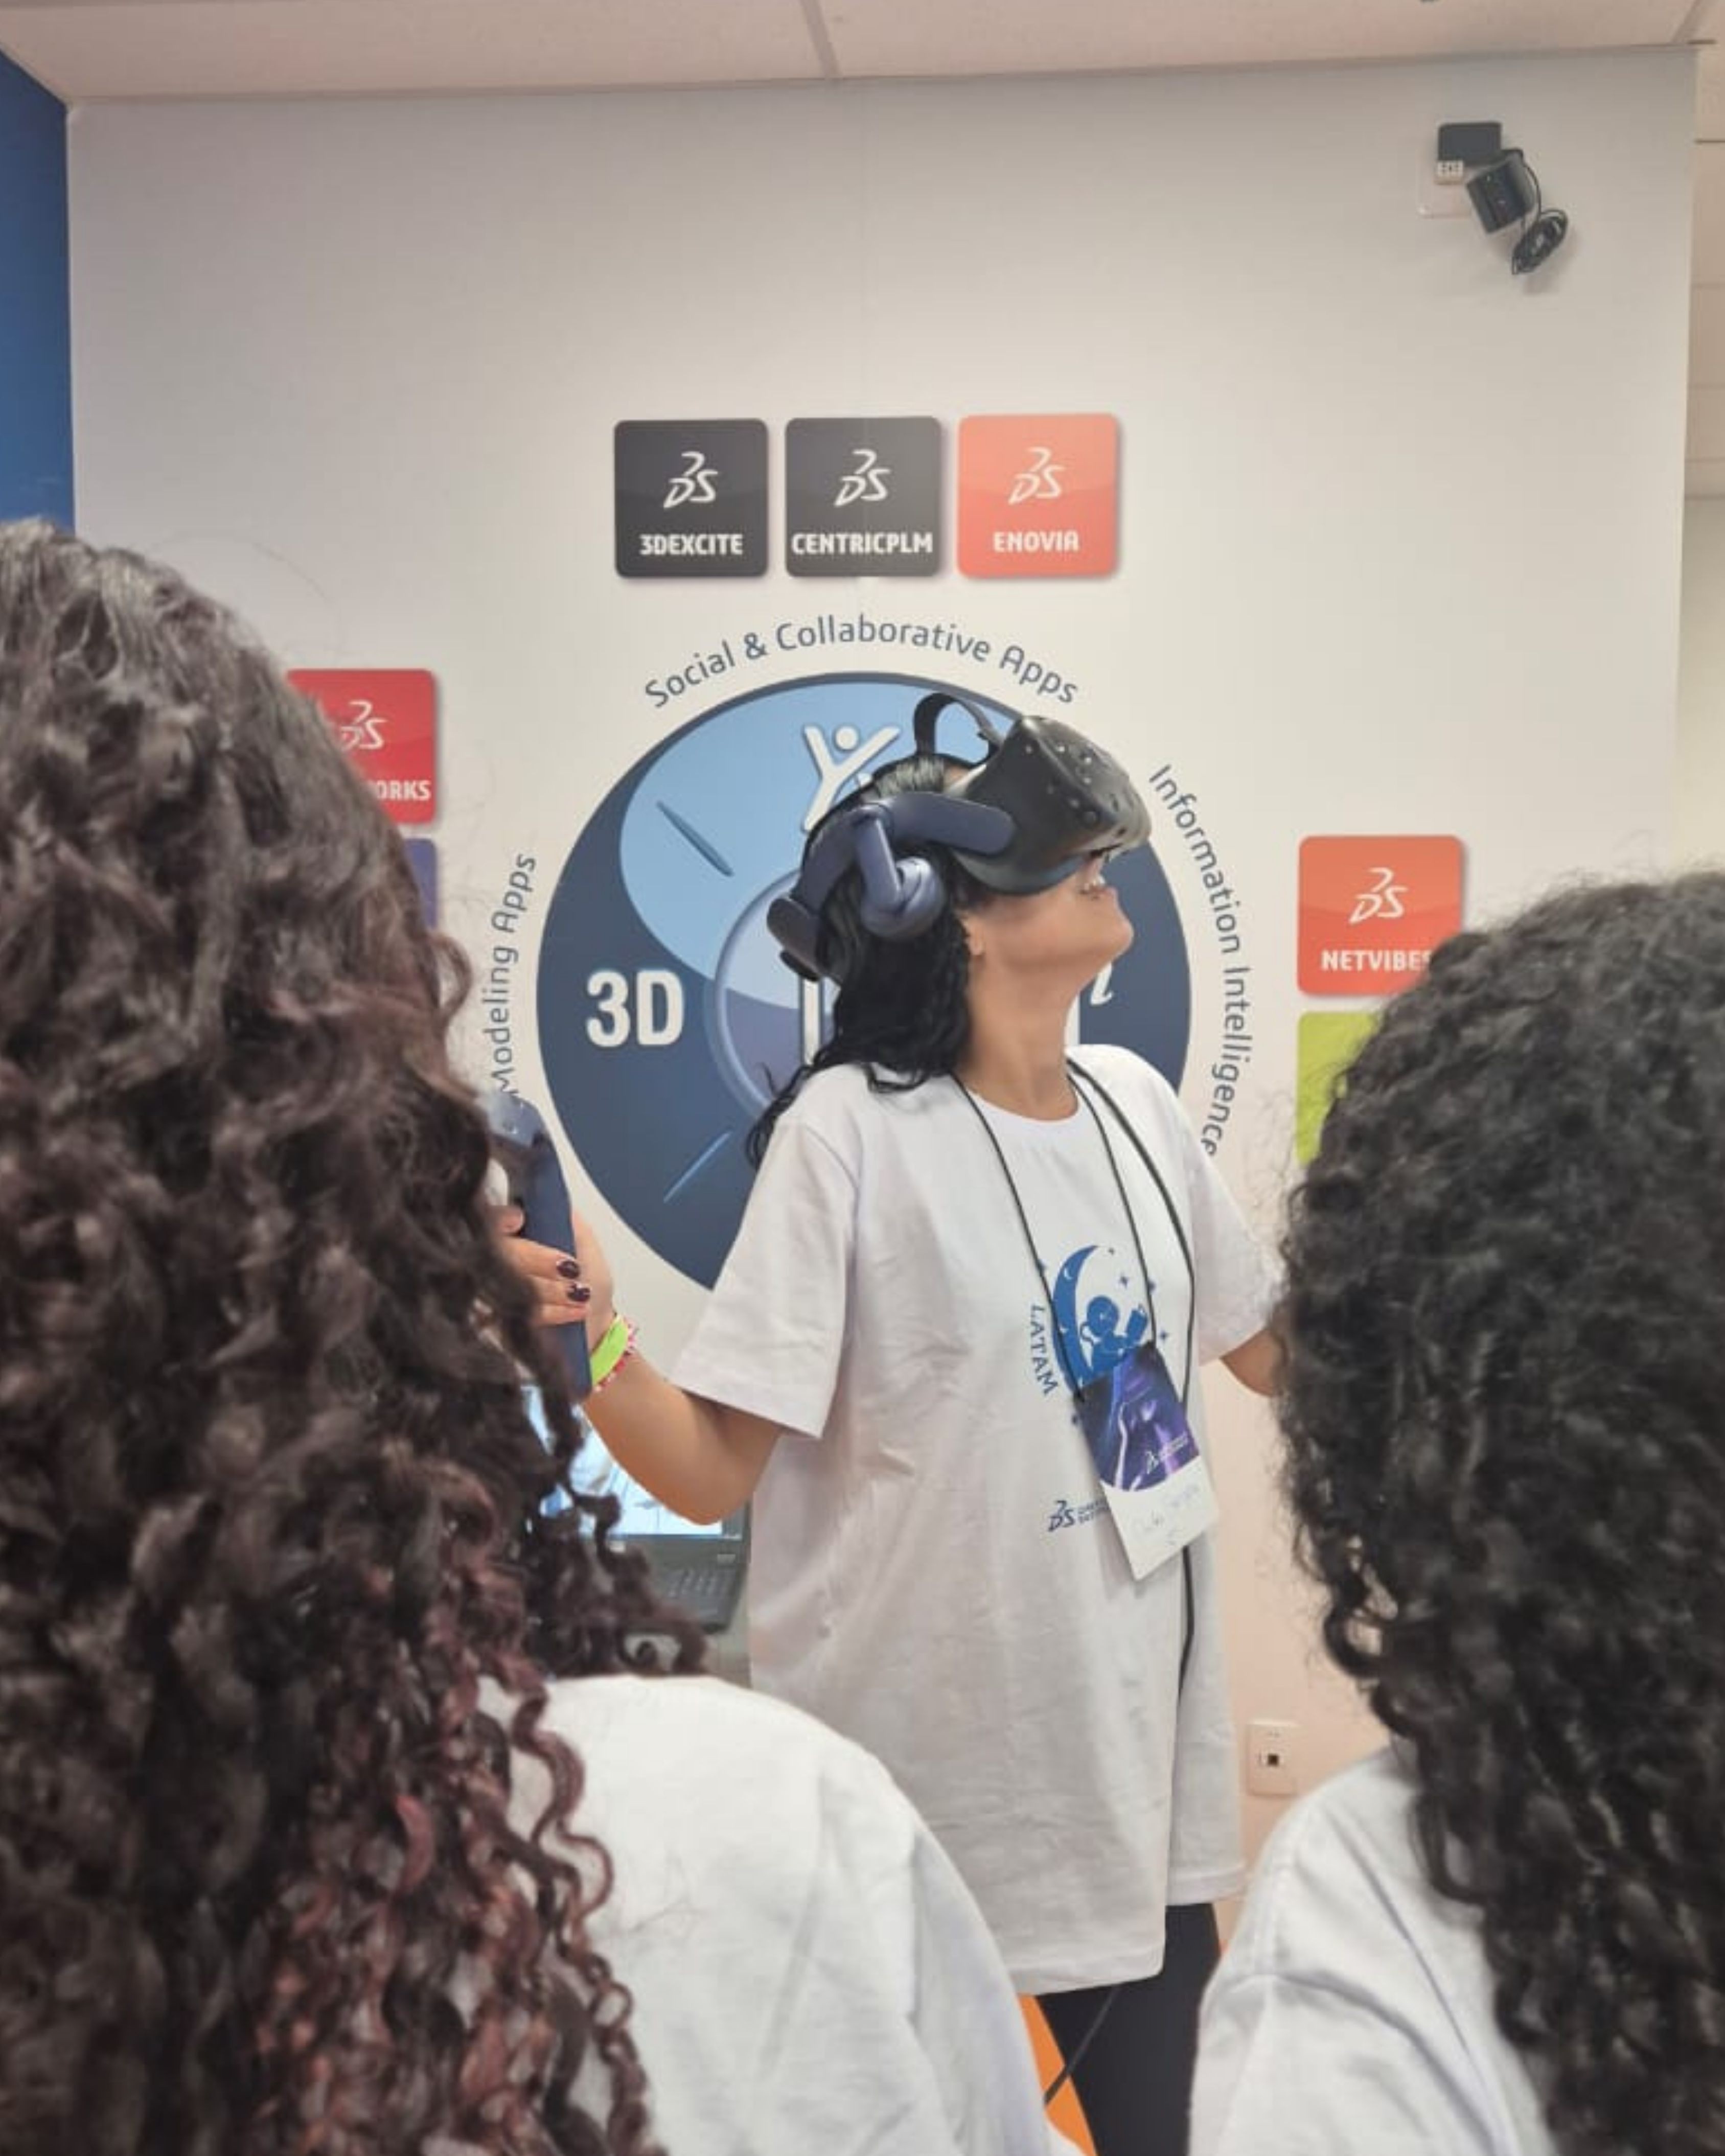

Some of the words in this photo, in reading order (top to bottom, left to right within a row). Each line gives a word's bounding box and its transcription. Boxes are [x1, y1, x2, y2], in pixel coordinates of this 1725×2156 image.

[640, 533, 743, 555] 3DEXCITE
[792, 532, 933, 554] CENTRICPLM
[993, 530, 1079, 552] ENOVIA
[645, 640, 735, 708] Social
[743, 632, 768, 660] &
[775, 612, 992, 663] Collaborative
[999, 644, 1078, 704] Apps
[491, 854, 537, 934] Apps
[1148, 764, 1241, 954] Information
[1201, 966, 1253, 1156] Intelligence
[481, 945, 519, 1094] Modeling
[586, 969, 684, 1047] 3D
[1030, 1304, 1059, 1396] LATAM
